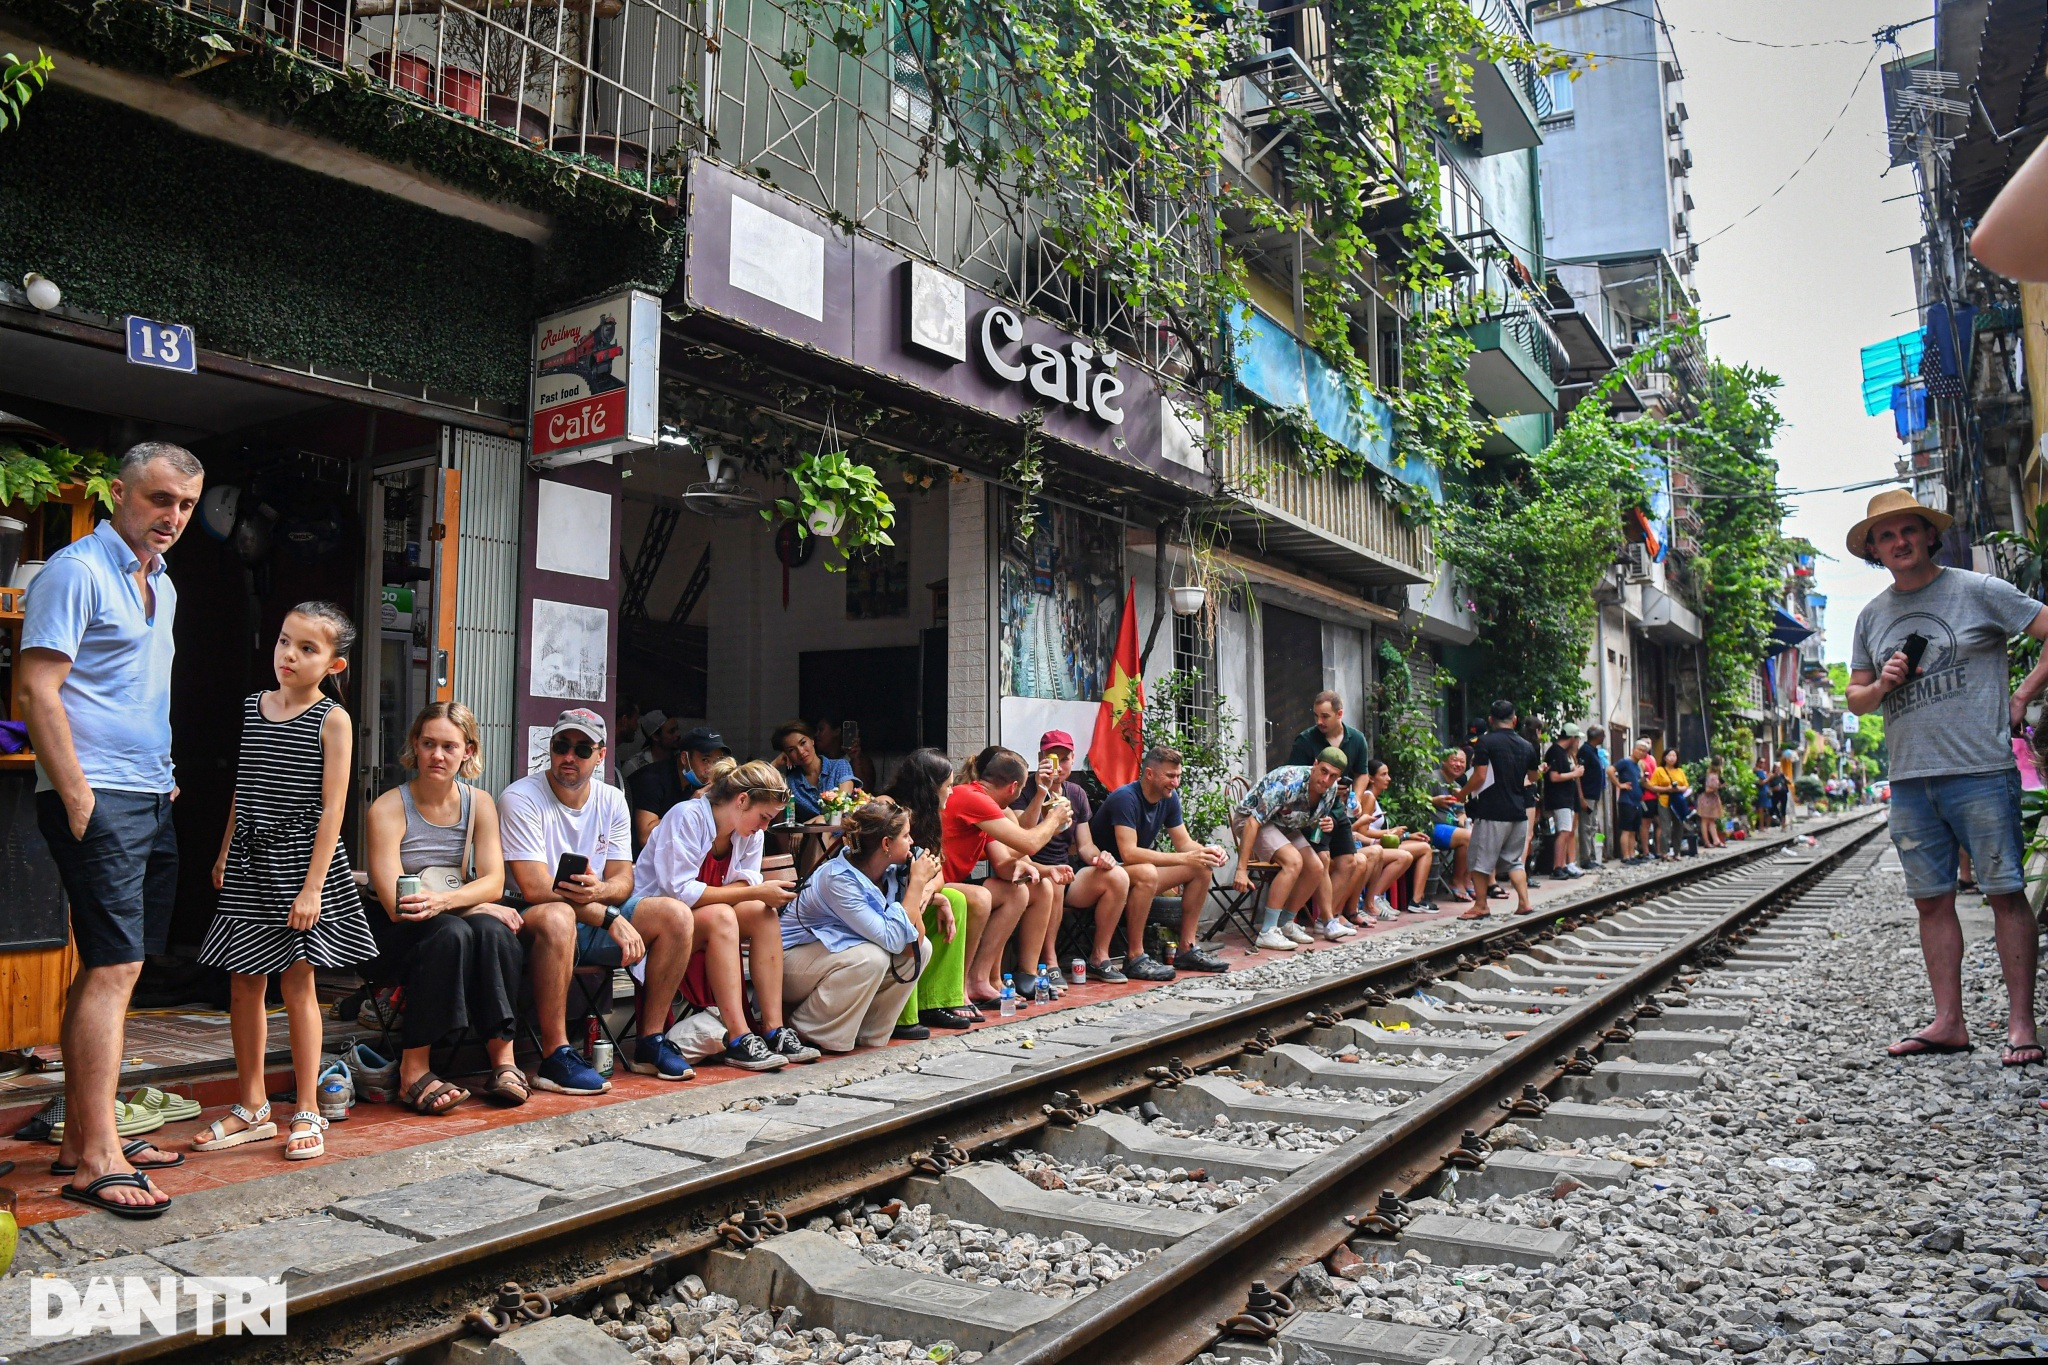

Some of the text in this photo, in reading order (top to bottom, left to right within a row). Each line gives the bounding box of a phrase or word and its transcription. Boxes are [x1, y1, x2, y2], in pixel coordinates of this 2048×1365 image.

[541, 325, 582, 350] Railway
[982, 306, 1125, 425] Café
[540, 385, 579, 405] Fast food
[548, 403, 606, 444] Café
[1884, 666, 1967, 714] OSEMITE
